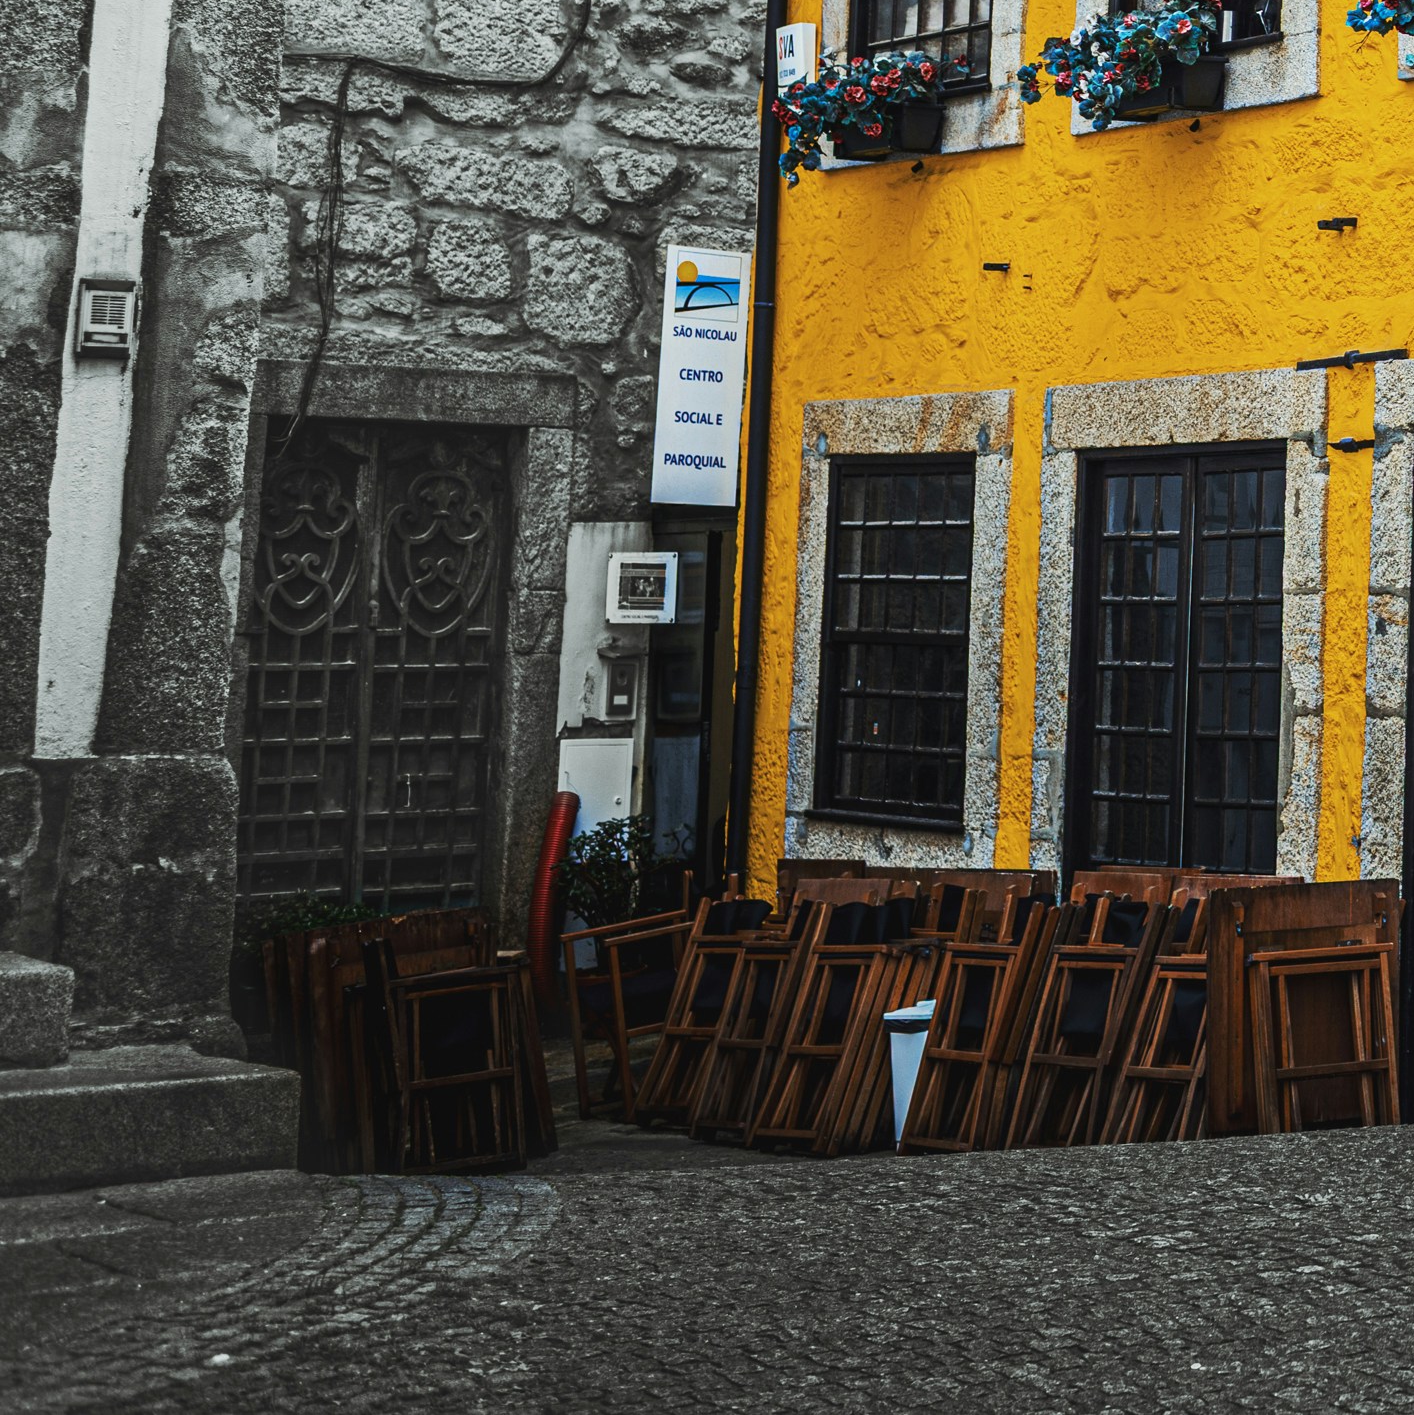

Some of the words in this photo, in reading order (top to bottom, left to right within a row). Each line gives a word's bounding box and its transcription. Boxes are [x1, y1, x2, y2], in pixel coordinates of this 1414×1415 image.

[779, 34, 794, 60] SVA
[673, 325, 692, 338] SÃO
[695, 328, 737, 341] NICOLAU
[680, 369, 723, 382] CENTRO
[674, 411, 713, 425] SOCIAL
[716, 414, 723, 425] E
[664, 453, 726, 470] PAROQUIAL
